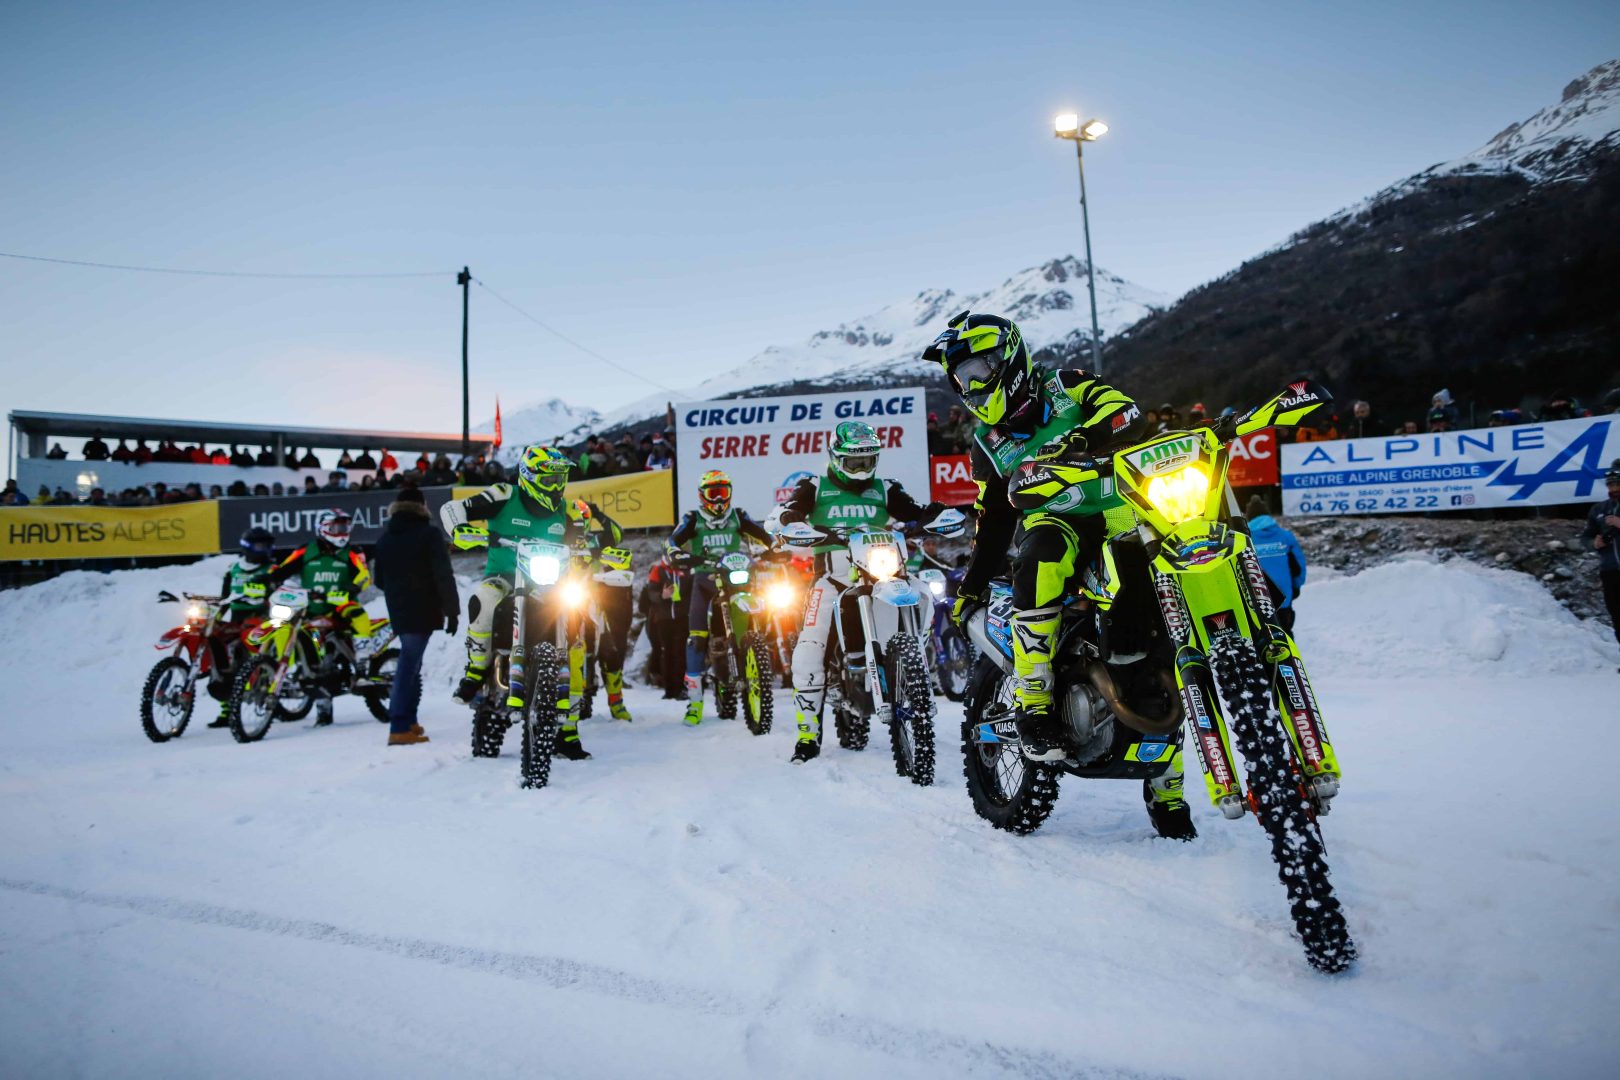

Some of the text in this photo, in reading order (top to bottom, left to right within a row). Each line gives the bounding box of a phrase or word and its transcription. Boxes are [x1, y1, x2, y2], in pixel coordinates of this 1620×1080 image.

[1008, 369, 1025, 397] LAZER
[685, 396, 915, 428] CIRCUIT DE GLACE
[1280, 392, 1318, 408] YUASA
[699, 433, 770, 460] SERRE
[1301, 426, 1545, 467] ALPINE
[1018, 471, 1052, 487] YUASA
[1293, 465, 1481, 487] CENTRE ALPINE GRENOBLE
[1299, 495, 1439, 513] 04 76 62 42 22
[9, 518, 186, 544] HAUTES ALPES
[250, 506, 392, 536] HAUT ALP
[1159, 585, 1185, 630] FRD
[1213, 627, 1234, 637] YUASA
[994, 722, 1017, 734] YUASA
[1294, 713, 1321, 761] MOTUL
[1205, 736, 1230, 784] MOTUL
